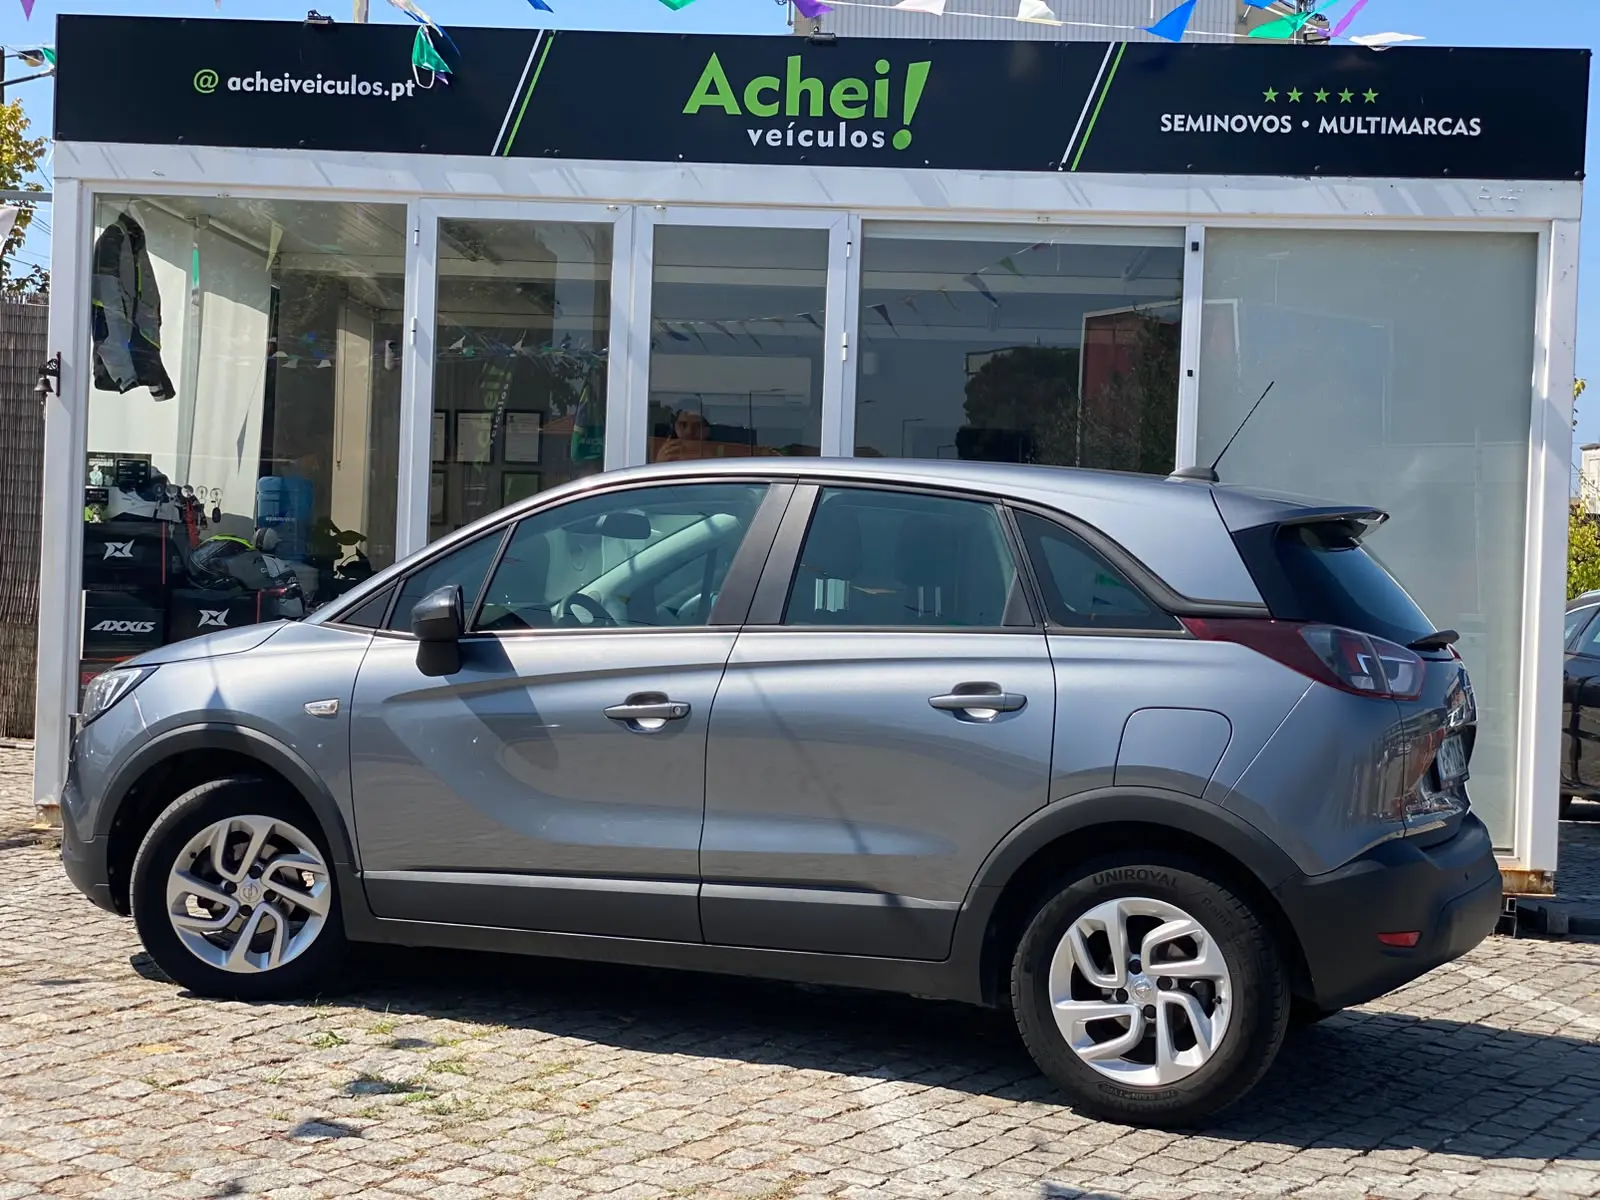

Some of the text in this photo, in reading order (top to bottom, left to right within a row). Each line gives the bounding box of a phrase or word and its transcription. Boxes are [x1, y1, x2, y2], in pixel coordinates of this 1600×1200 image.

[227, 71, 415, 101] acheiveiculos.pt
[747, 121, 886, 149] veículos
[1160, 113, 1482, 136] SEMINOVOS MULTIMARCAS
[91, 620, 157, 633] AXXIS
[1093, 868, 1178, 888] UNIROYAL
